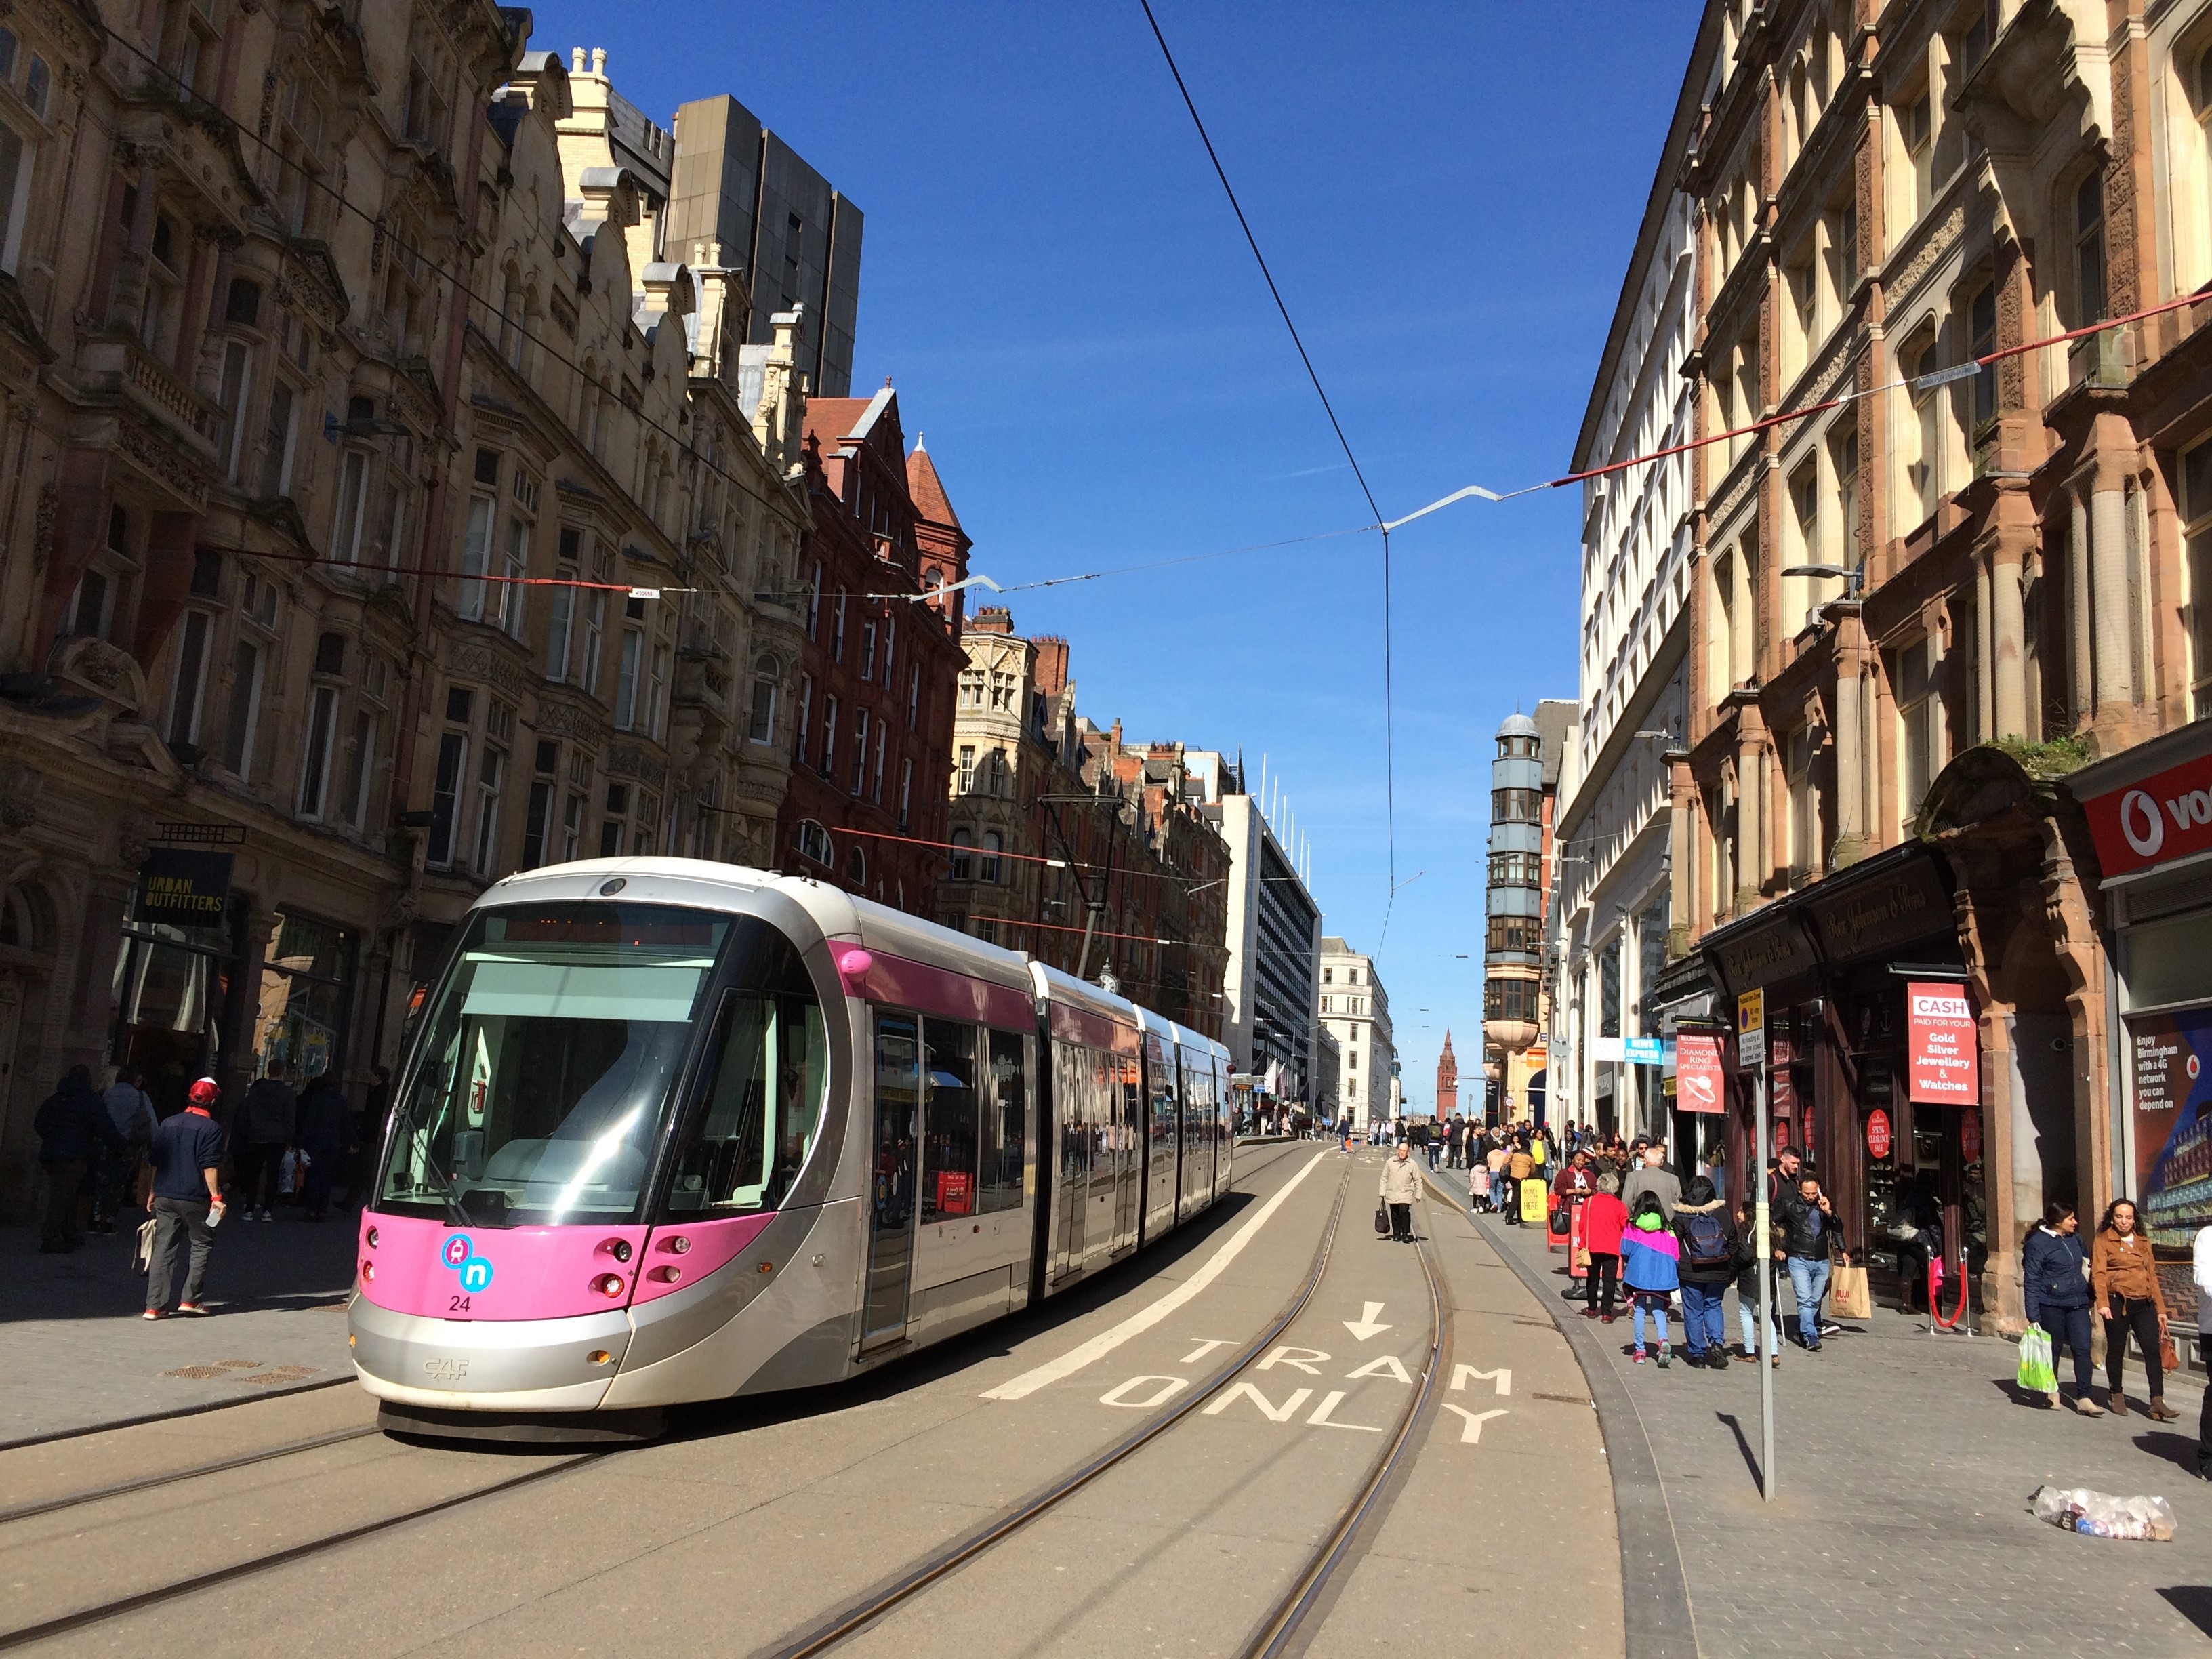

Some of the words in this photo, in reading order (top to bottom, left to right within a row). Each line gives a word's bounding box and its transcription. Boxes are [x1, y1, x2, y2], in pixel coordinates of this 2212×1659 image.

[148, 876, 193, 894] URBAN
[145, 891, 222, 912] OUTFITTERS
[1918, 1000, 1965, 1014] CASH
[1913, 1018, 1931, 1026] PAID
[1933, 1019, 1948, 1027] FOR
[1949, 1019, 1971, 1028] YOUR
[1631, 1039, 1654, 1048] NEWS
[1746, 1034, 1757, 1043] loading
[1929, 1033, 1956, 1044] Gold
[2137, 1035, 2156, 1047] Enjoy
[1679, 1048, 1721, 1057] DIAMOND
[1753, 1043, 1761, 1052] except
[1927, 1044, 1959, 1055] Silver
[2137, 1045, 2178, 1059] Birmingham
[1626, 1048, 1659, 1059] EXPRESS
[1744, 1054, 1754, 1063] signed
[1689, 1056, 1711, 1065] RING
[1916, 1056, 1970, 1069] Jewellery
[2138, 1061, 2152, 1071] with
[2153, 1062, 2158, 1070] a
[2158, 1059, 2167, 1069] 4G
[1679, 1063, 1721, 1071] SPECIALISTS
[1939, 1069, 1948, 1078] &
[2139, 1072, 2166, 1084] network
[1919, 1079, 1968, 1092] Watches
[2139, 1088, 2151, 1099] you
[2152, 1087, 2165, 1097] can
[2139, 1099, 2164, 1112] depend
[2165, 1100, 2174, 1109] on
[1872, 1126, 1885, 1134] SPRING
[1868, 1134, 1889, 1143] CLEARANCE
[1875, 1143, 1884, 1152] SALE
[1524, 1202, 1538, 1210] HERE
[449, 1295, 471, 1312] 24
[1179, 1338, 1511, 1396] TRAM
[1099, 1376, 1509, 1444] ONLY
